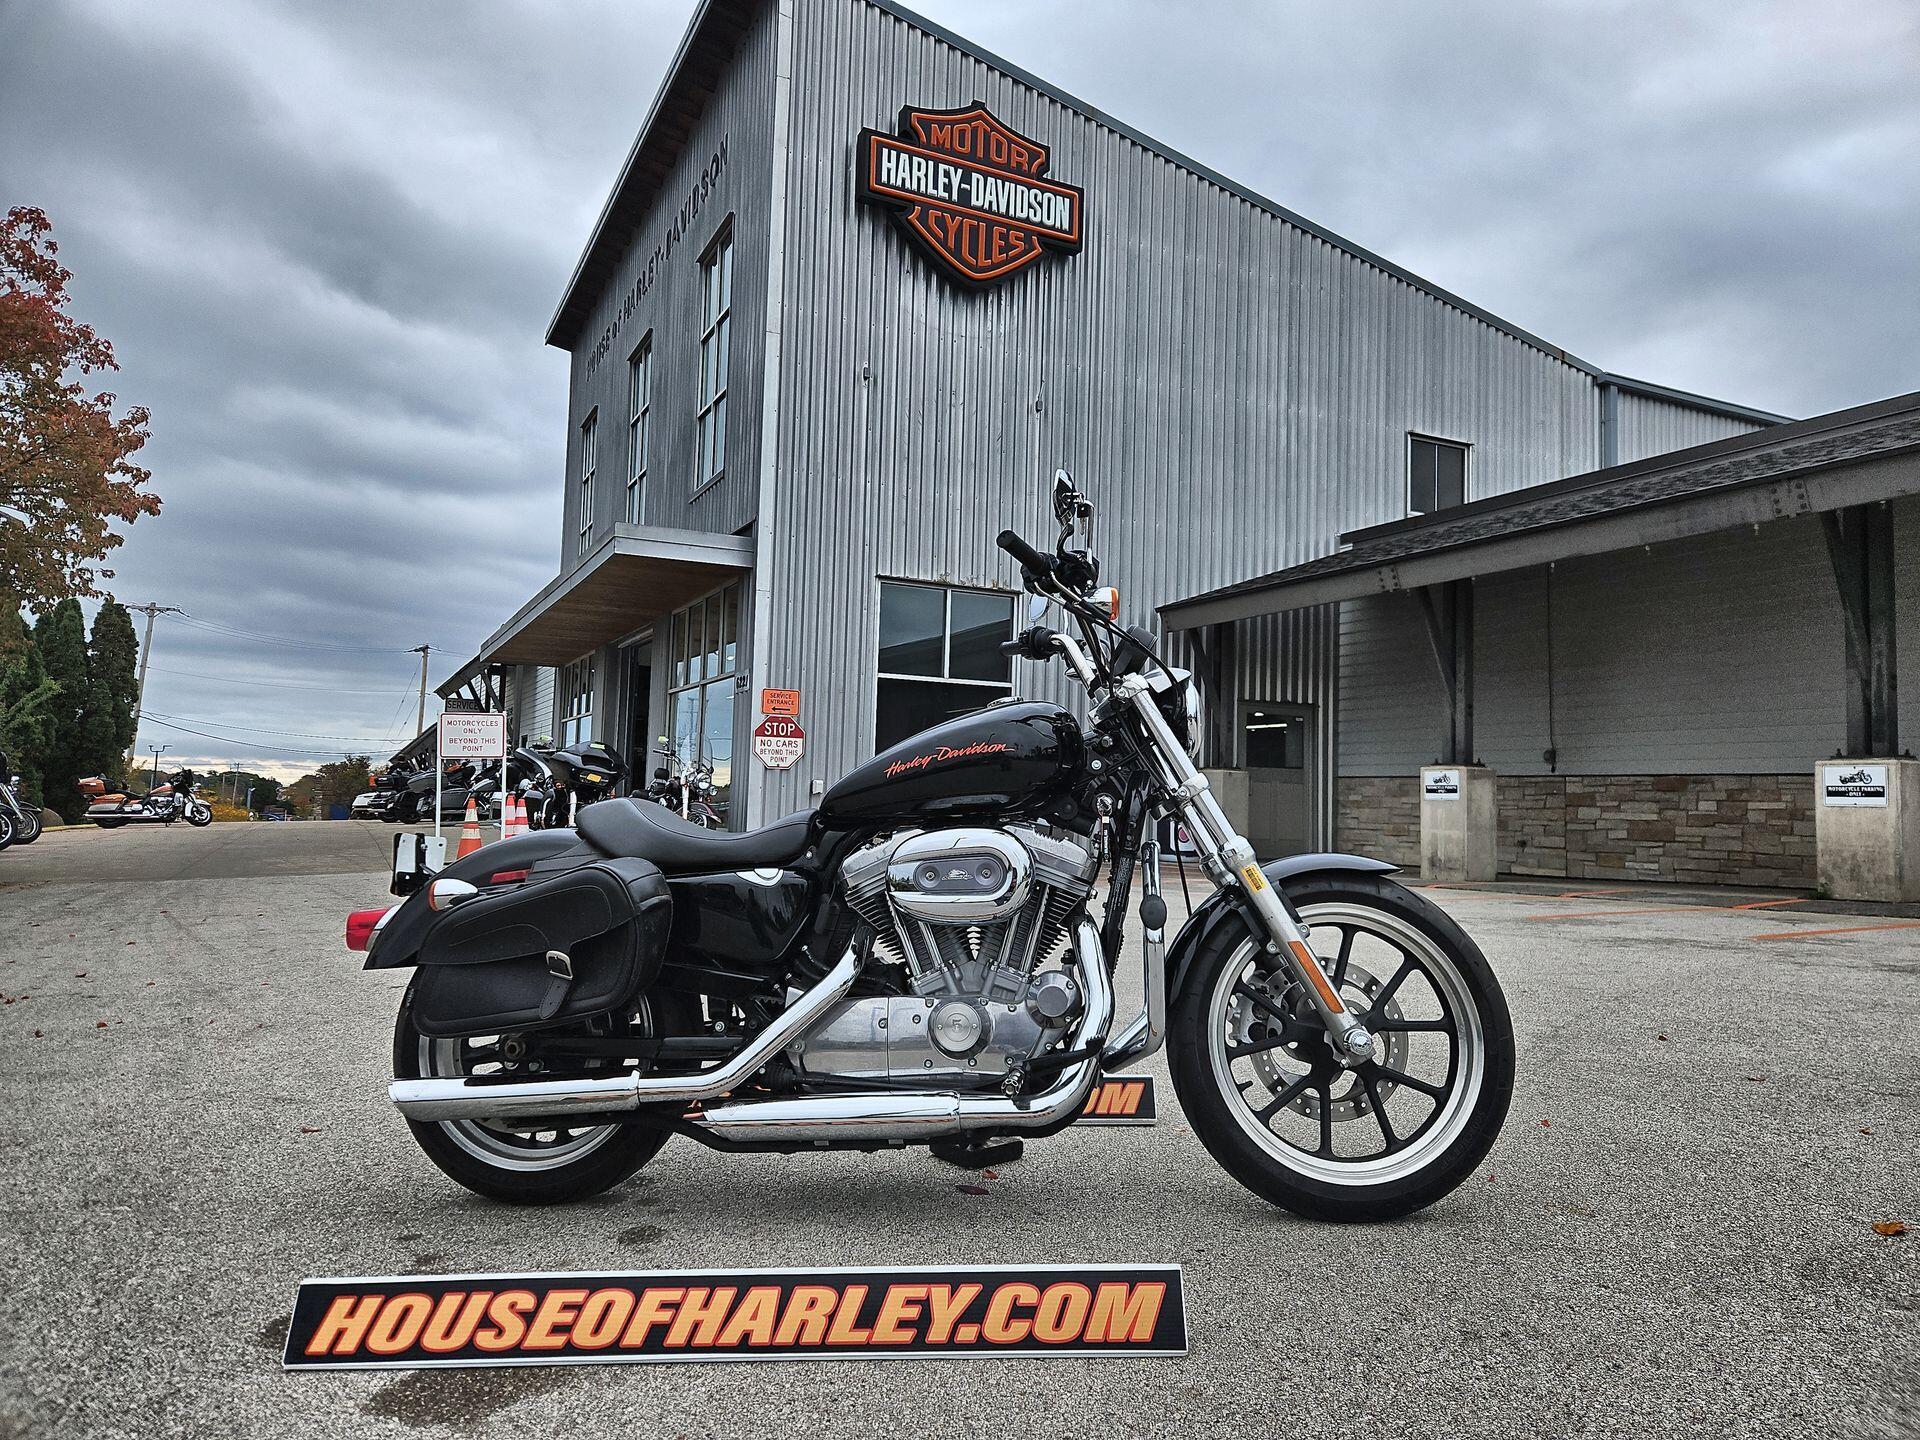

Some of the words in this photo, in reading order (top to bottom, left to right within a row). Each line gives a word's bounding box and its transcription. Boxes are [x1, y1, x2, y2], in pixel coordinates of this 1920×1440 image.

[930, 120, 1030, 174] MOTOR
[881, 147, 1071, 232] HARLEY-DAVIDSON
[928, 209, 1025, 268] CYCLES
[587, 326, 611, 382] HOUSE
[623, 131, 729, 324] HARLEY-DAVIDSON
[447, 699, 479, 710] SERVICE
[767, 698, 795, 706] ENTRANCE
[770, 692, 792, 700] SERVICE
[764, 722, 796, 736] STOP
[759, 748, 784, 756] BEYOND
[760, 739, 772, 747] NO
[775, 740, 799, 749] CARS
[884, 741, 1016, 779] Harley-Davidson
[304, 1281, 1167, 1356] HOUSEOFHARLEY.COM
